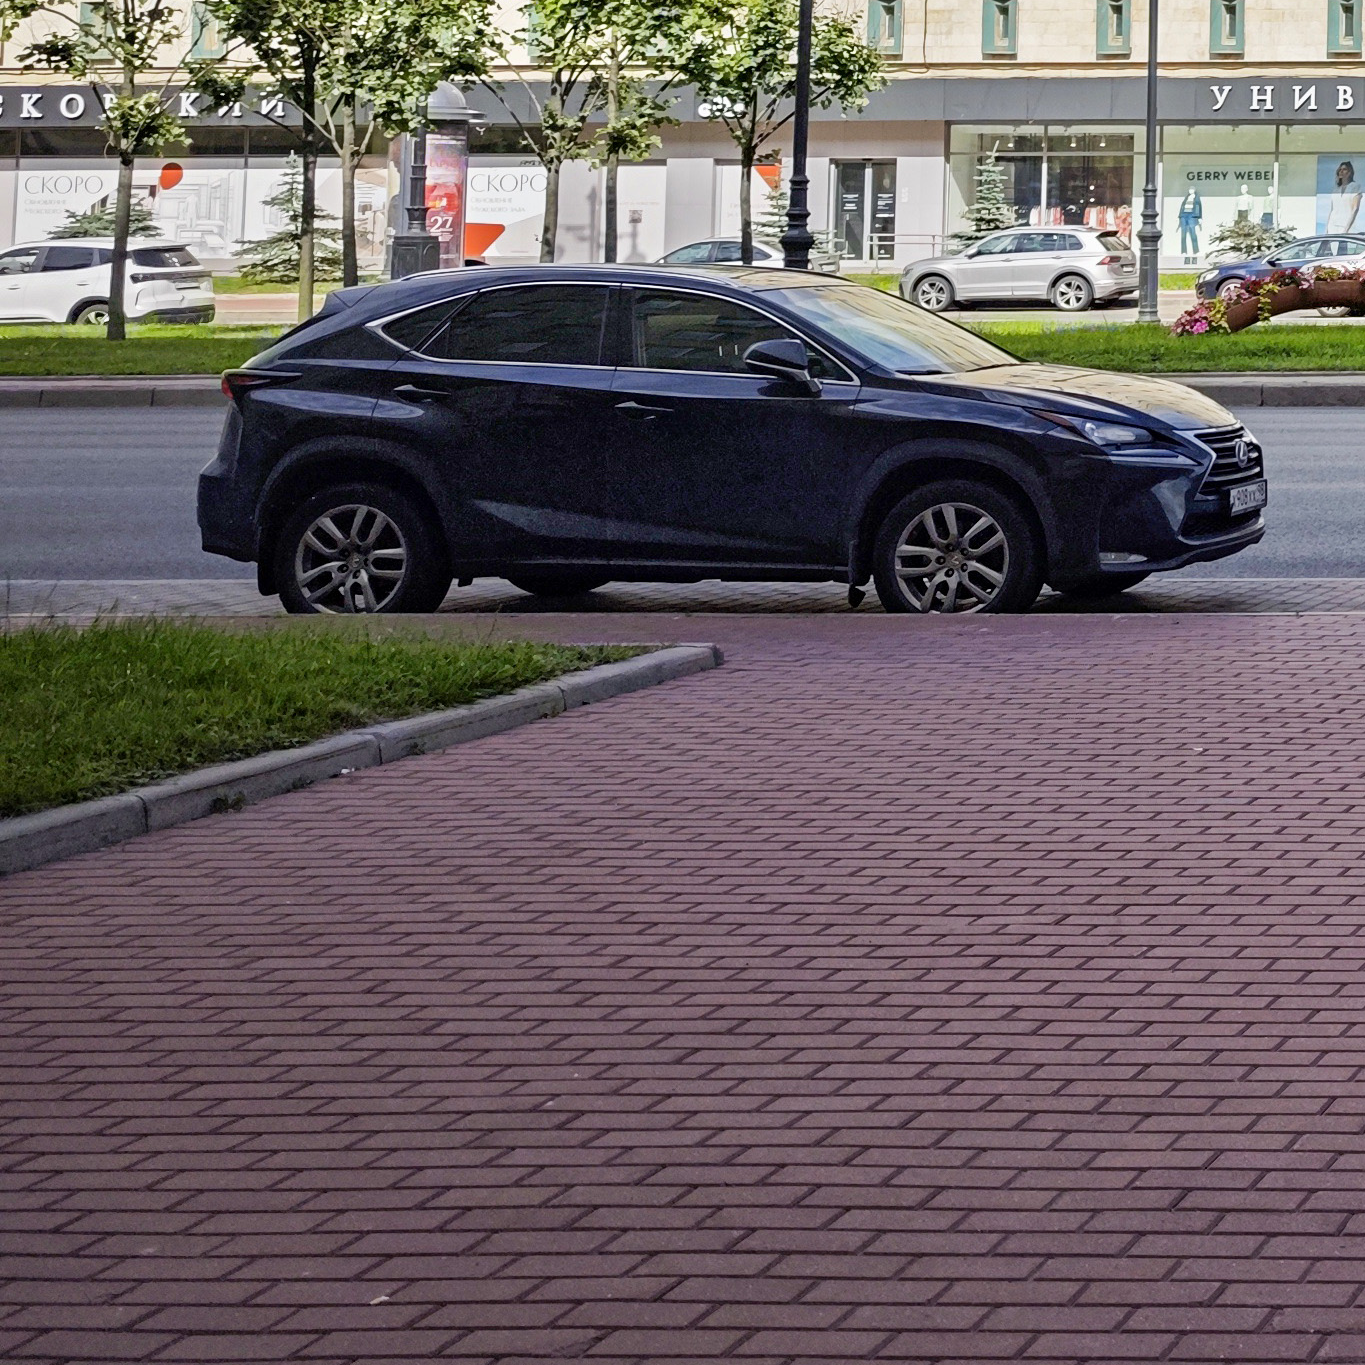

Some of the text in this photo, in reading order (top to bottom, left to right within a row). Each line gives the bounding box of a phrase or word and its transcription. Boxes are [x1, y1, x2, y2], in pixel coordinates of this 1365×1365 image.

[24, 176, 104, 194] СКОРО
[470, 174, 548, 193] СКОРО
[1186, 171, 1275, 181] GERRY WEBE
[430, 215, 454, 233] 27
